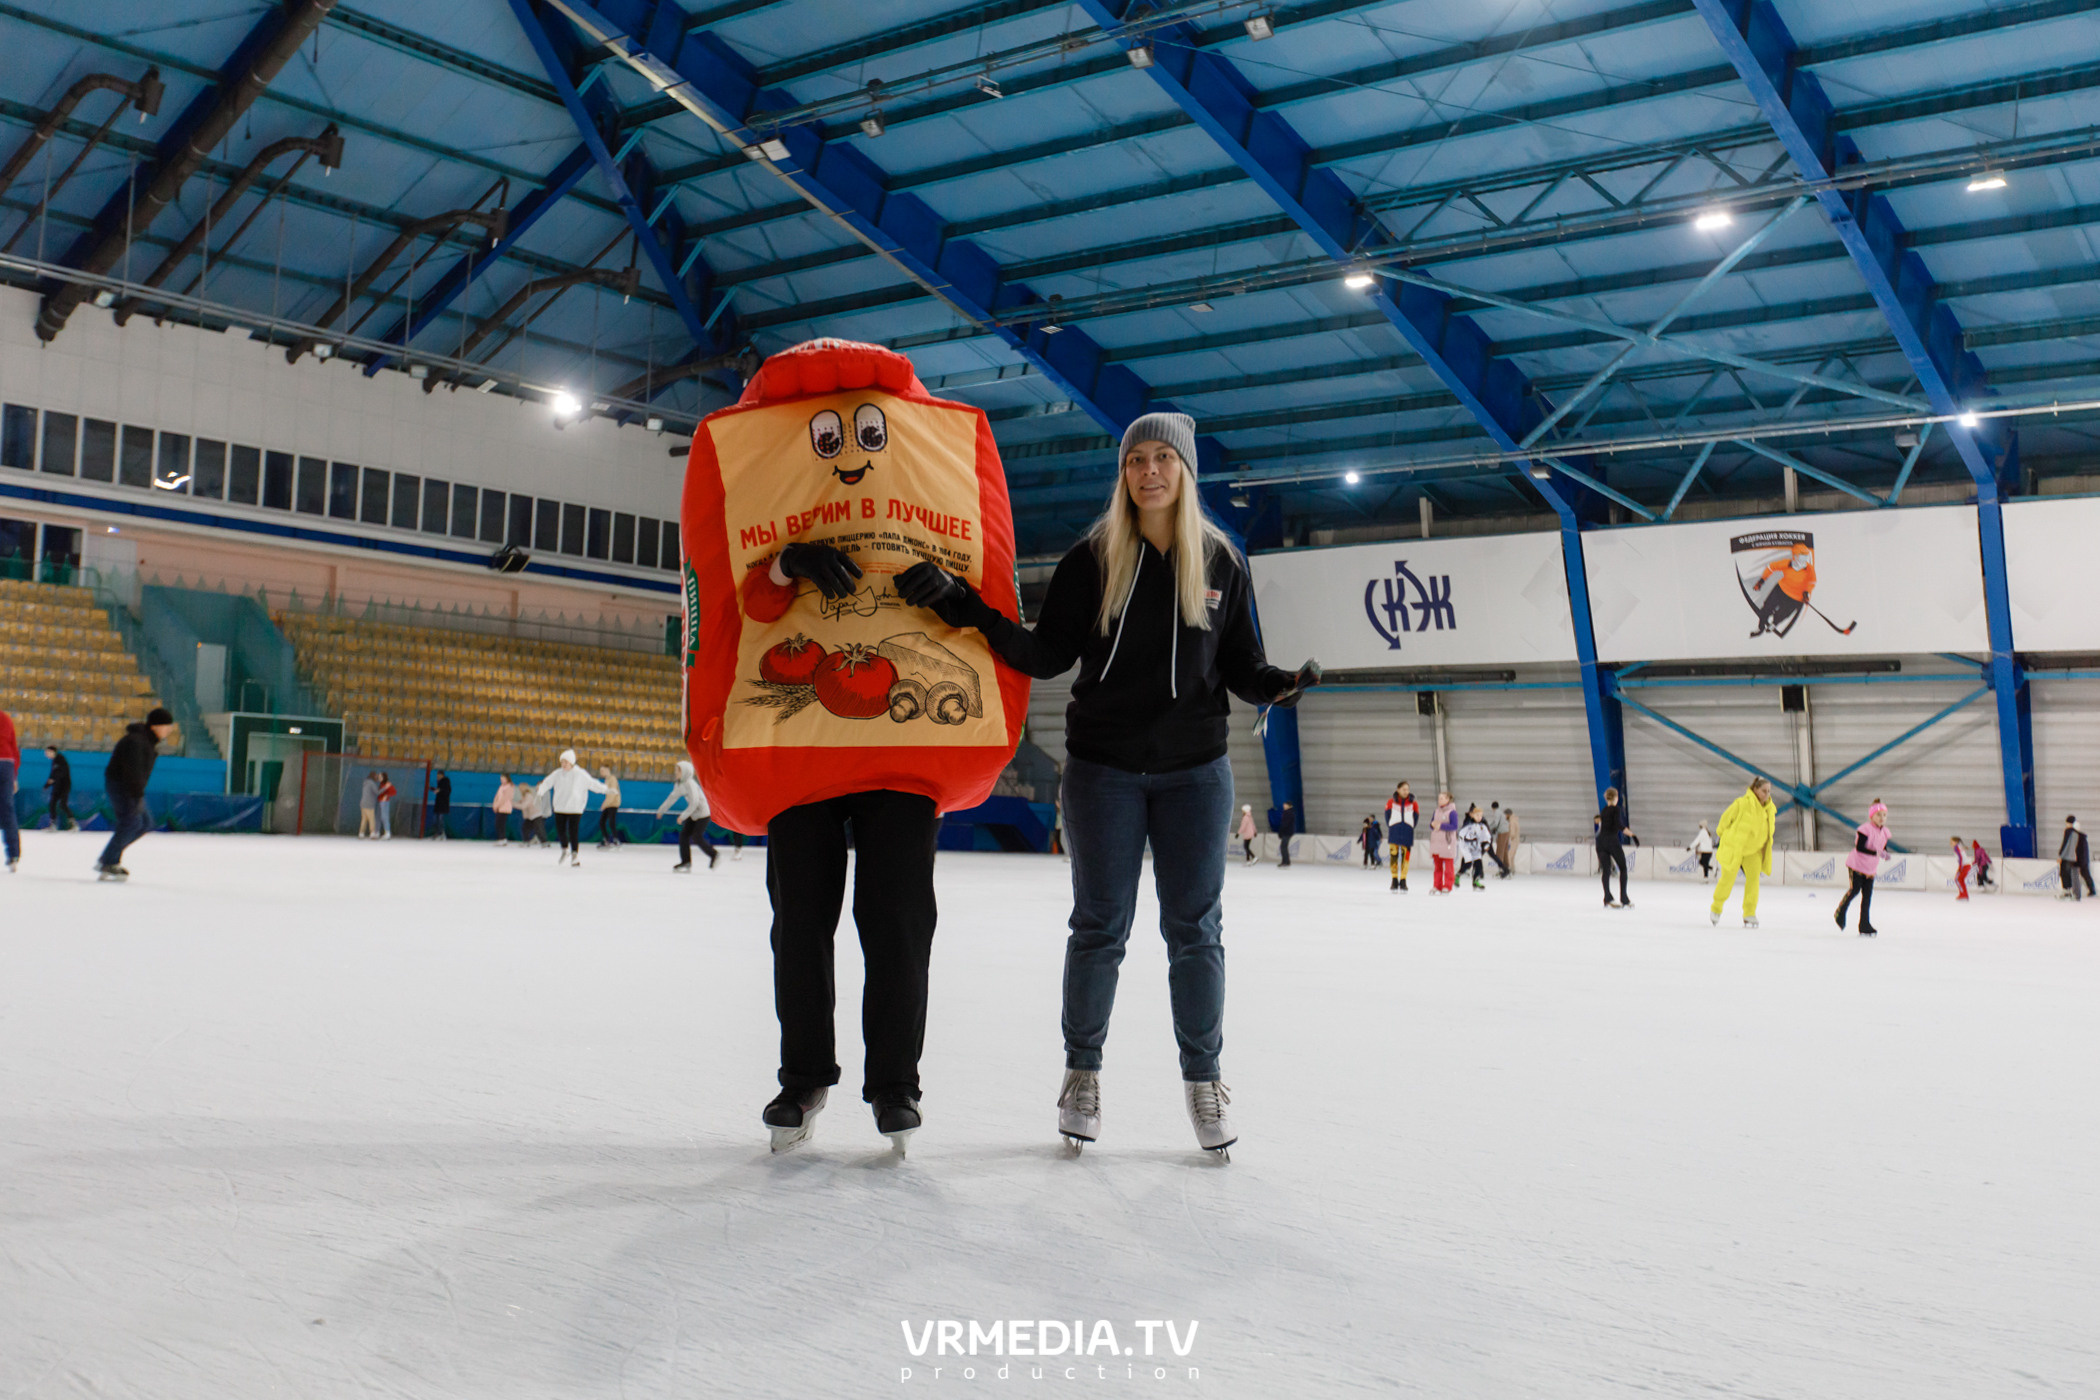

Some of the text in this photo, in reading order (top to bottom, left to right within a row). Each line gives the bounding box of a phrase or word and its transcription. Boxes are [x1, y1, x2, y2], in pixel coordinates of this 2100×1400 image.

[740, 498, 972, 550] МЫ ВЕРИМ В ЛУЧШЕЕ
[871, 541, 910, 555] ГОТОВИТЬ
[912, 548, 944, 566] ЛУЧШУЮ
